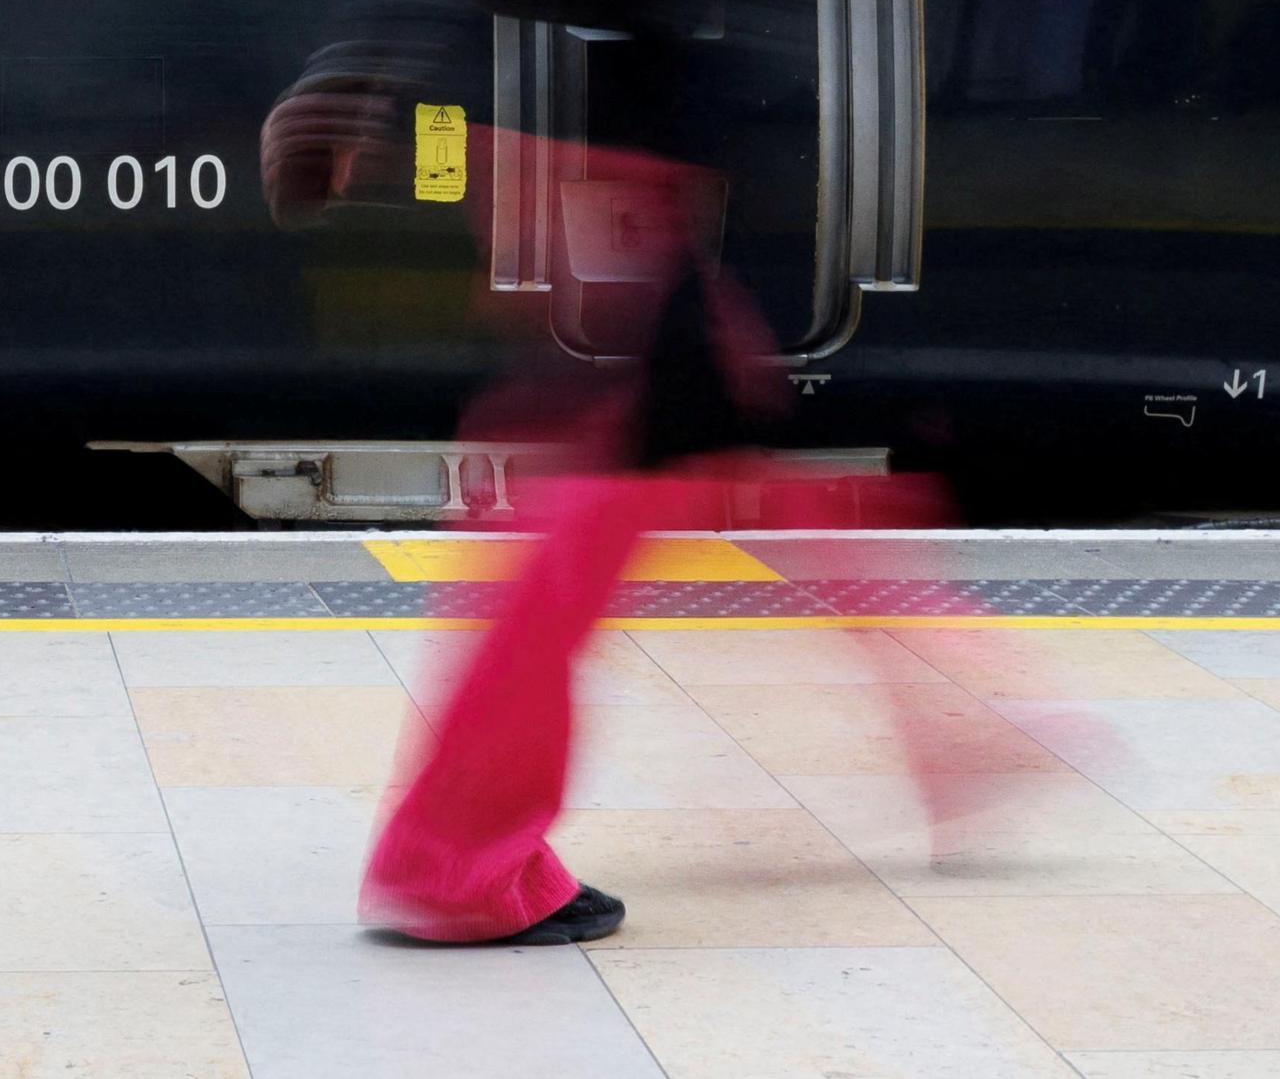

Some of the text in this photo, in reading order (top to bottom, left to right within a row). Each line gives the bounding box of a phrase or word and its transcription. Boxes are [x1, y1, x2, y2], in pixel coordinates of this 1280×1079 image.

[429, 124, 456, 132] Caution
[108, 155, 226, 209] 010
[1253, 369, 1267, 399] 1
